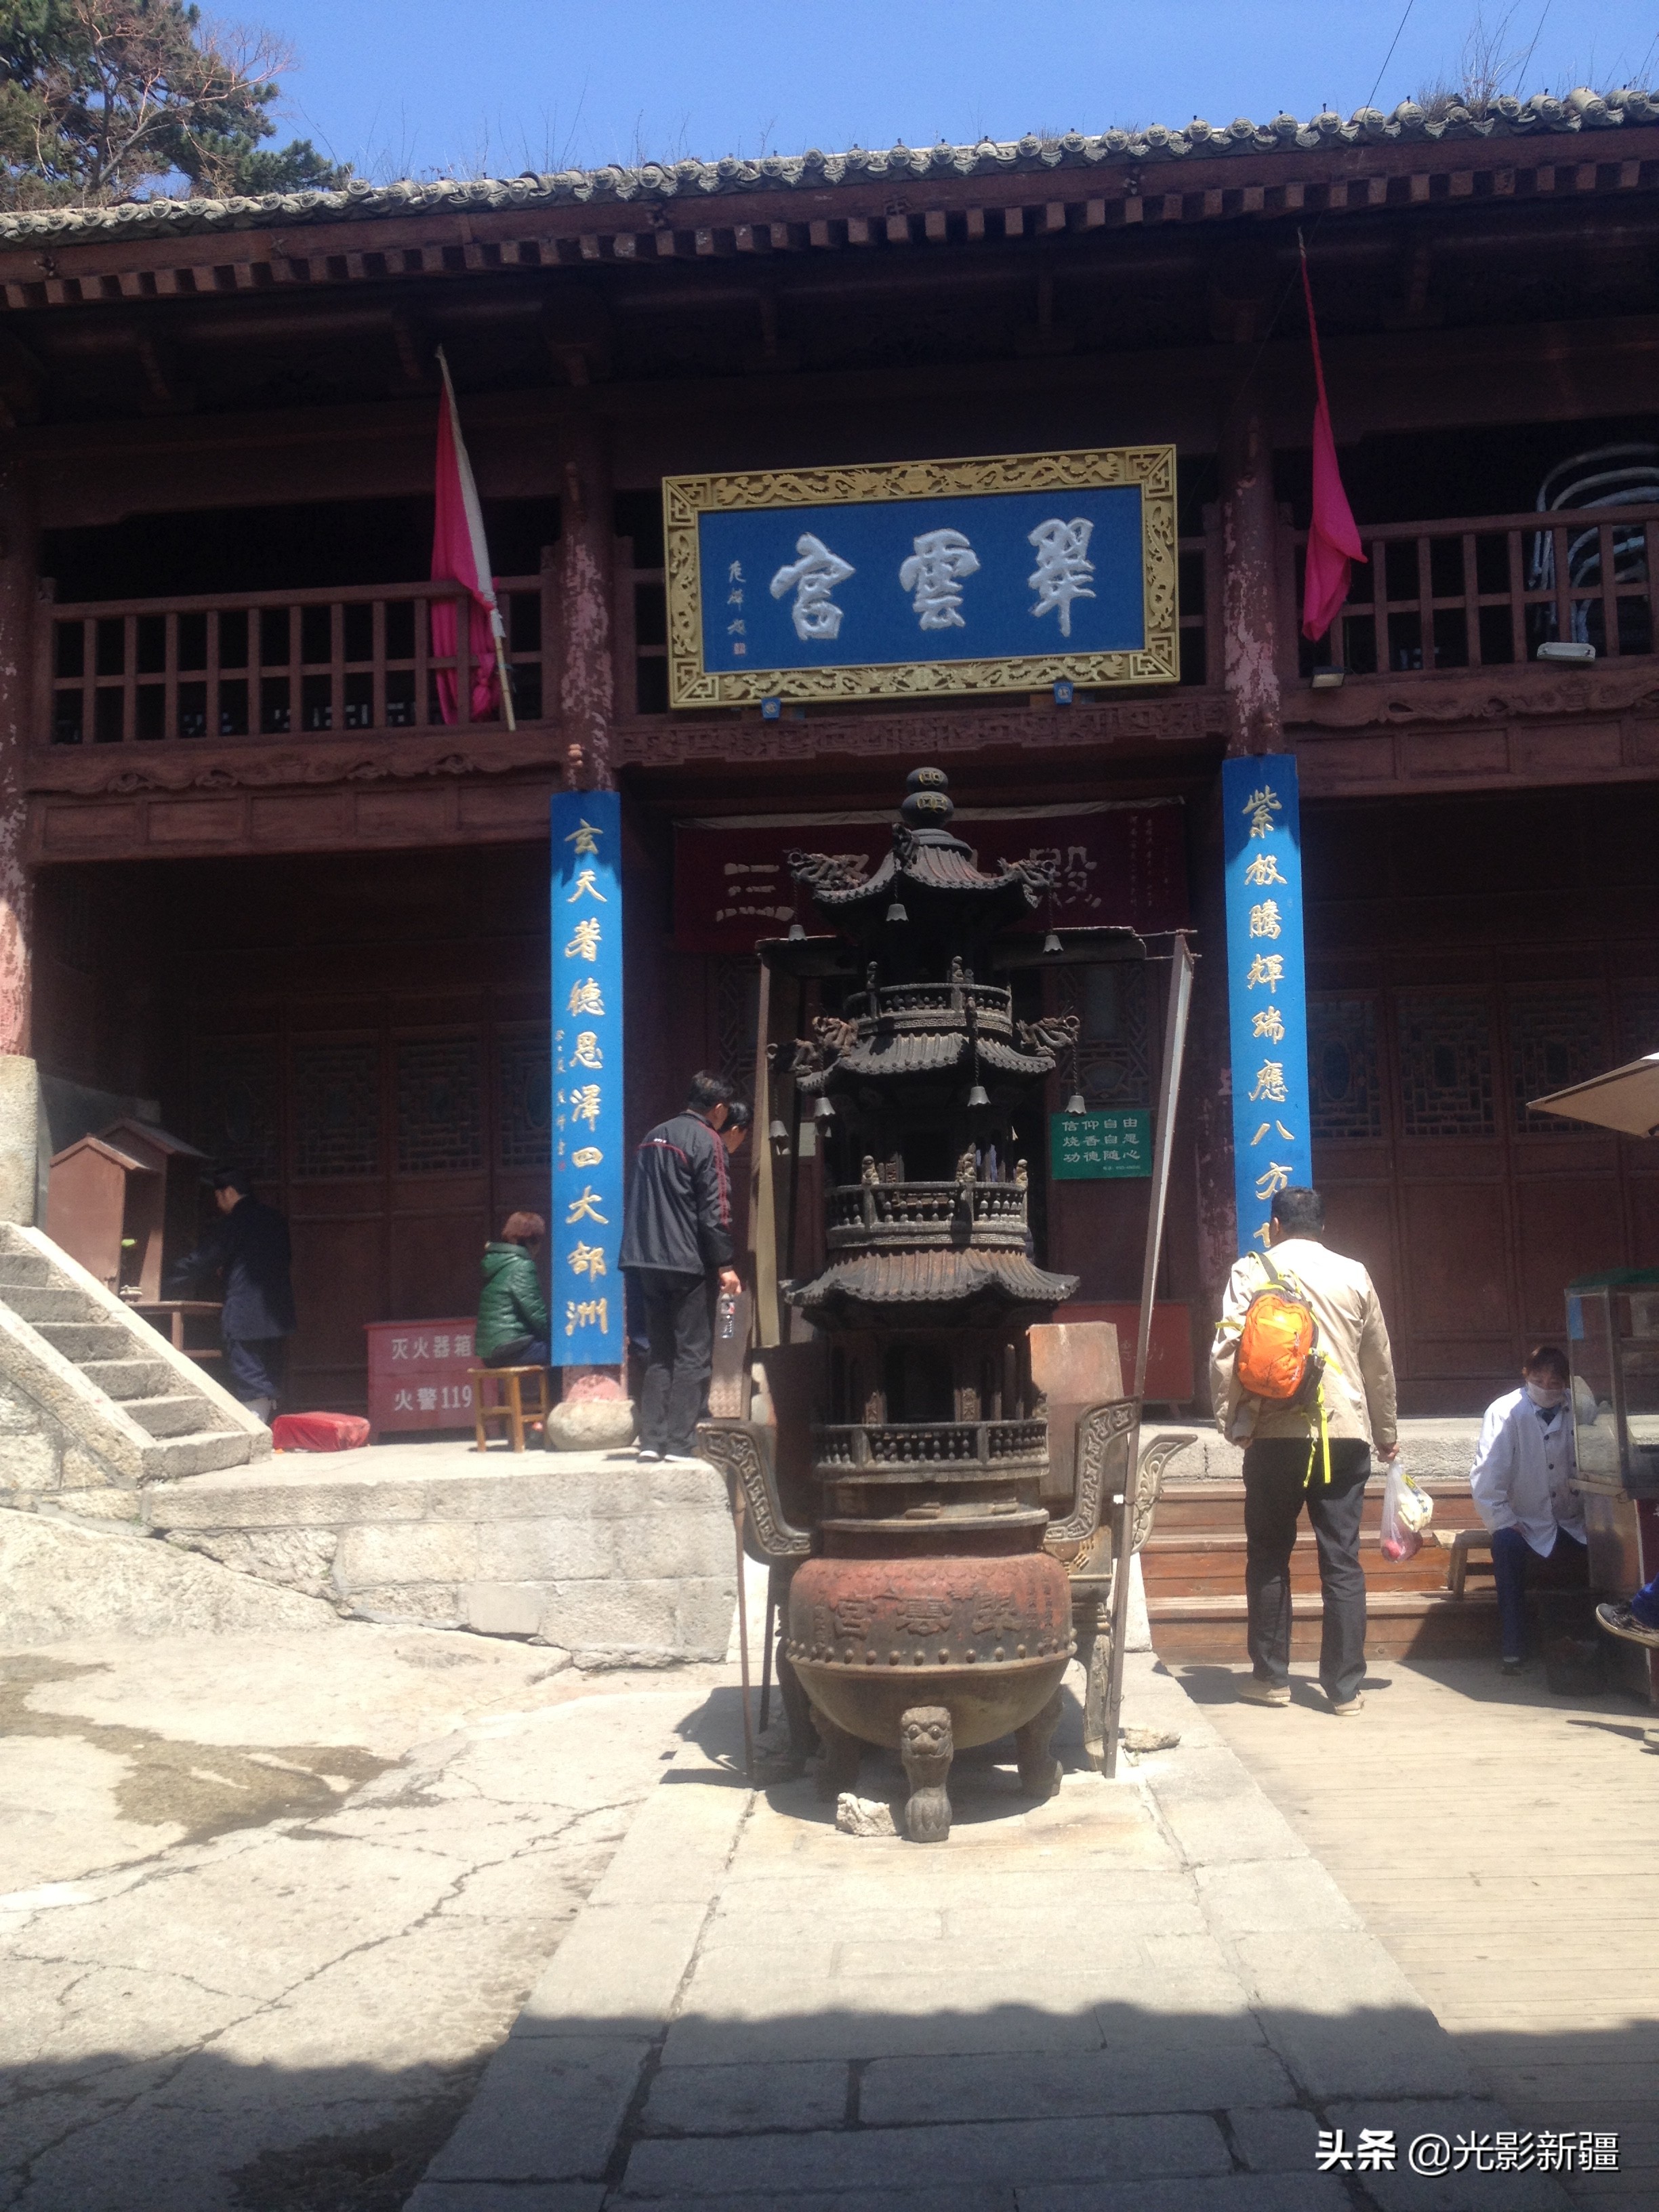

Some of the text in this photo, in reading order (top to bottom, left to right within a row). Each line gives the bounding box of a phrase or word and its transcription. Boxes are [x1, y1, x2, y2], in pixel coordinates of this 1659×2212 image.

[1062, 1118, 1138, 1132] 信仰自由
[1063, 1149, 1141, 1162] 功德随心
[392, 1334, 472, 1360] 灭火器箱
[394, 1385, 473, 1412] 火警119
